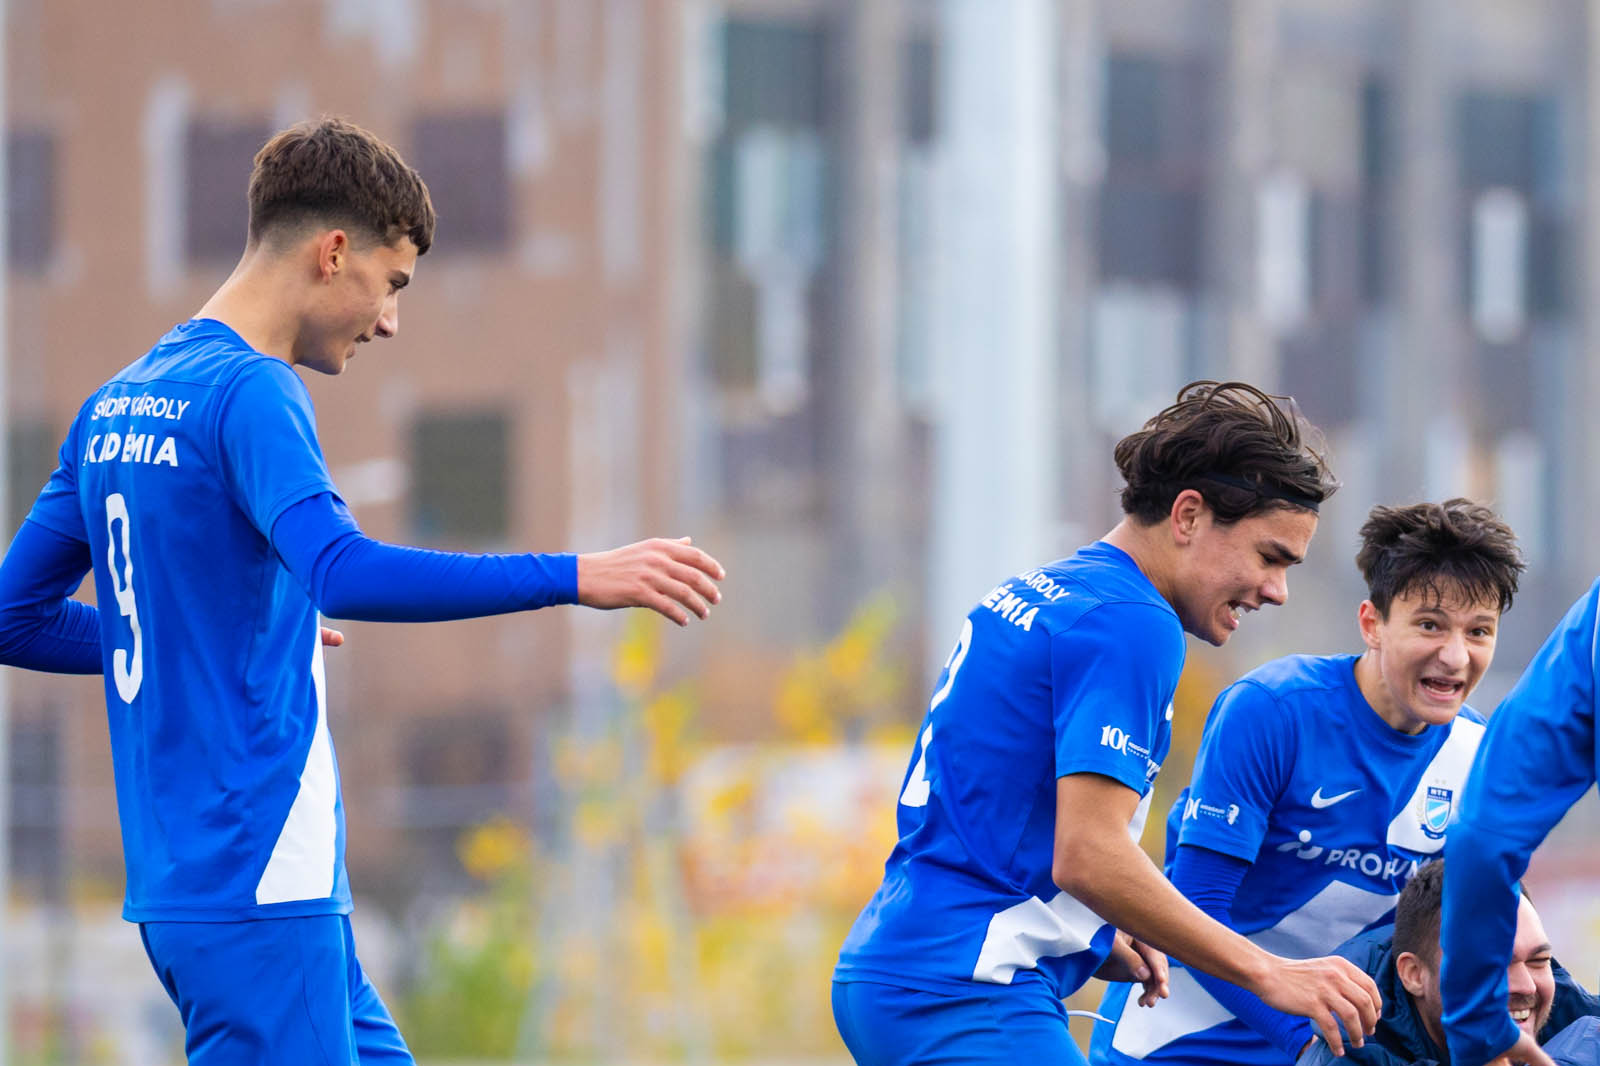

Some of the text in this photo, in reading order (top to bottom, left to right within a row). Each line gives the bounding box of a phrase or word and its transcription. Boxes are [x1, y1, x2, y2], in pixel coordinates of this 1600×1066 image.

[105, 492, 143, 705] 9
[981, 583, 1040, 632] ÉMIA
[1019, 568, 1071, 603] ÁROLY
